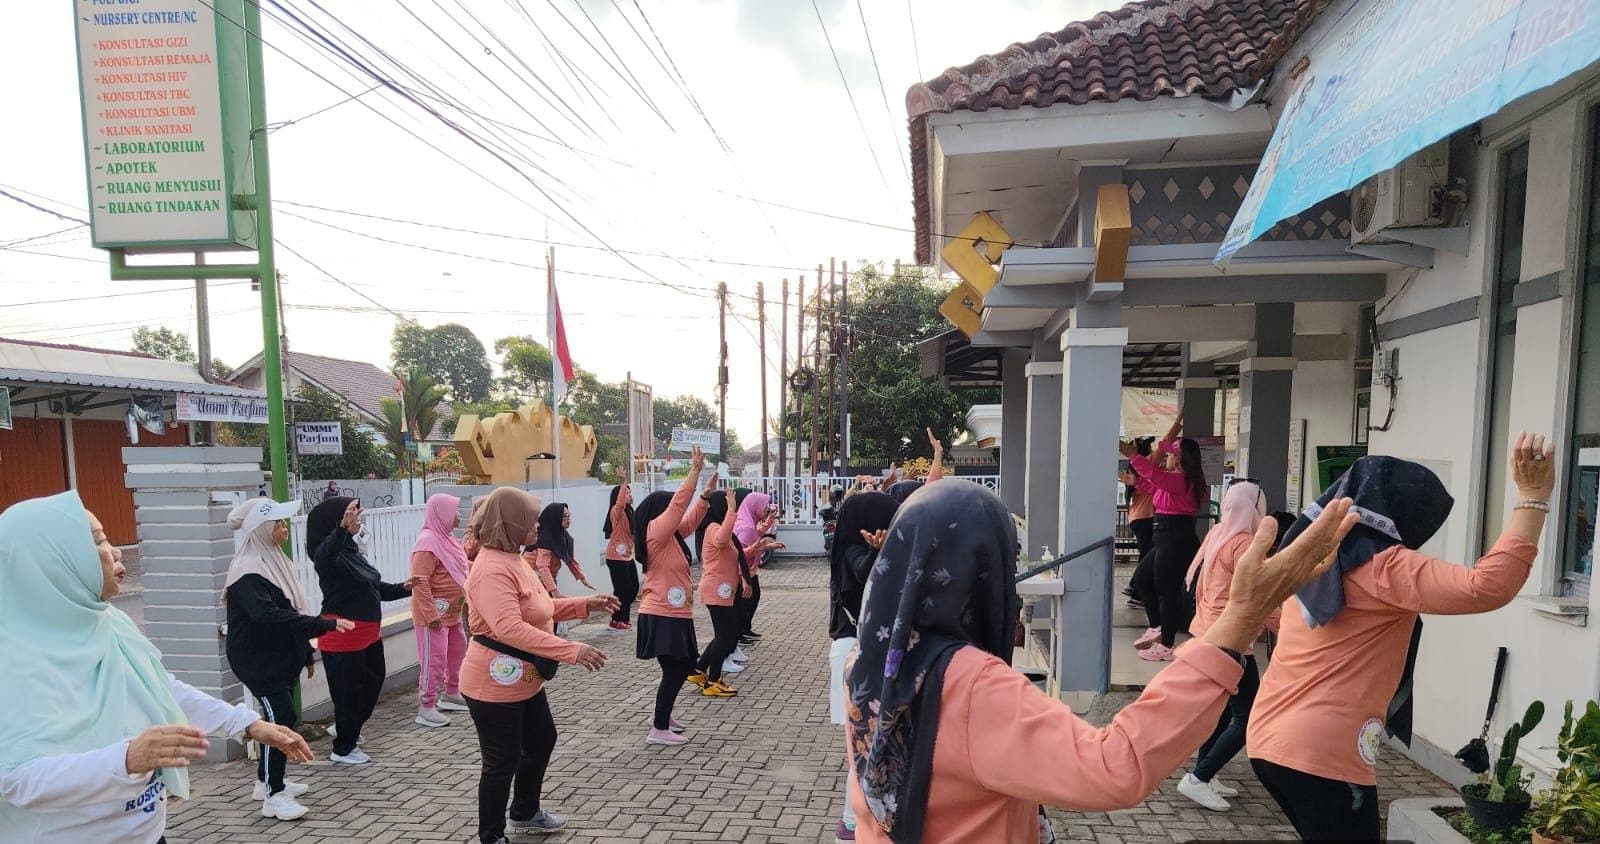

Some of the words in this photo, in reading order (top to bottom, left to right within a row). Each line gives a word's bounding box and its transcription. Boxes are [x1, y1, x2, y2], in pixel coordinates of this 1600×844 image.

[93, 12, 140, 26] NURSERY
[142, 10, 198, 25] CENTRE/NC
[98, 38, 164, 51] KONSULTASI
[165, 37, 188, 48] GIZI
[100, 55, 165, 68] KONSULTASI
[167, 53, 212, 65] REMAJA
[101, 73, 166, 85] KONSULTASI
[168, 71, 188, 82] HIV
[103, 90, 168, 102] KONSULTASI
[169, 88, 191, 99] TBC
[105, 107, 169, 120] KONSULTASI
[171, 105, 196, 116] UBM
[106, 124, 142, 137] KLINIK
[144, 123, 193, 135] SANITASI
[1323, 93, 1416, 174] PUSKESMAS
[104, 140, 206, 156] LABORATORIUM
[106, 161, 158, 175] APOTEK
[107, 181, 151, 195] RUANG
[155, 179, 222, 193] MENYUSUI
[109, 200, 152, 215] RUANG
[155, 199, 220, 213] TINDAKAN
[296, 424, 338, 433] "UMMI"
[297, 433, 339, 445] Parfum
